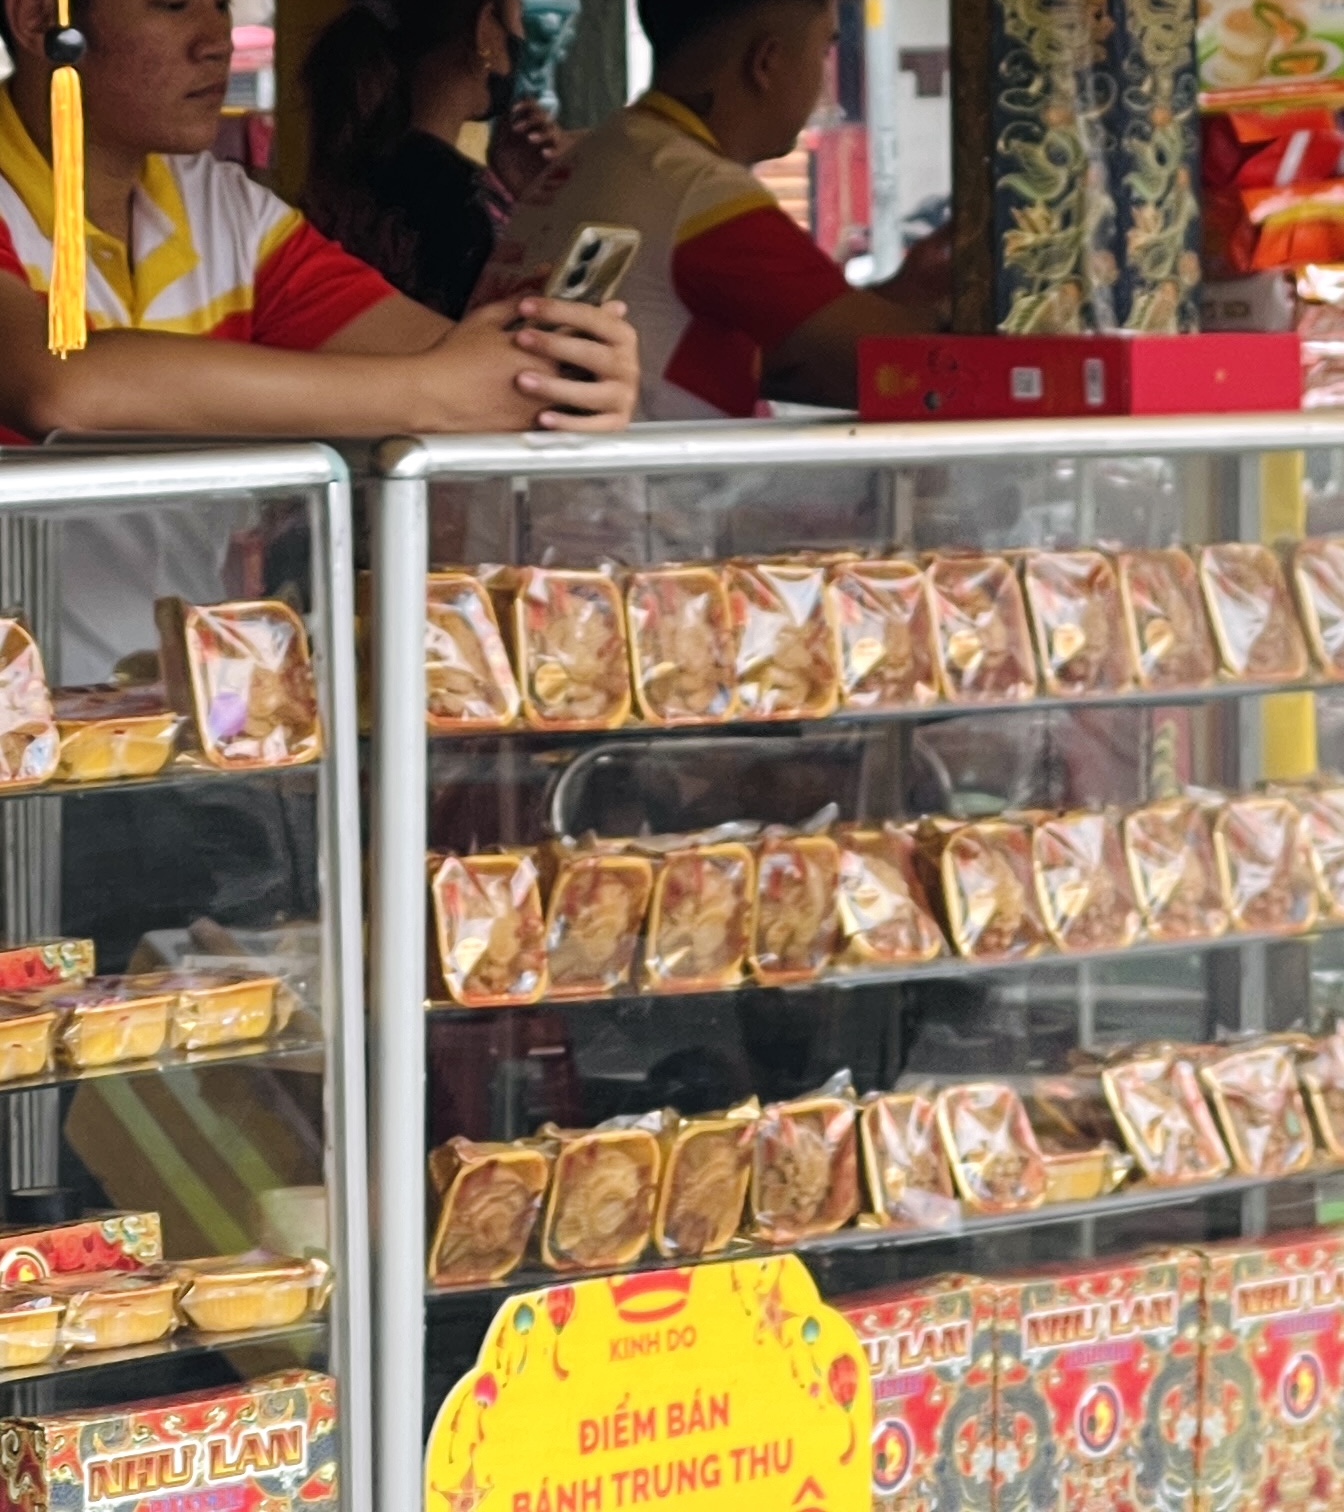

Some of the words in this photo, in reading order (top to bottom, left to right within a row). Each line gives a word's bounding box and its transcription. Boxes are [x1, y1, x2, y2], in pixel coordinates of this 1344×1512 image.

[609, 1330, 660, 1362] KINH
[208, 1424, 304, 1479] LAN
[579, 1392, 656, 1456] ĐIỂM
[667, 1388, 730, 1438] BÁN
[611, 1454, 722, 1508] TRUNG
[729, 1437, 794, 1484] THU
